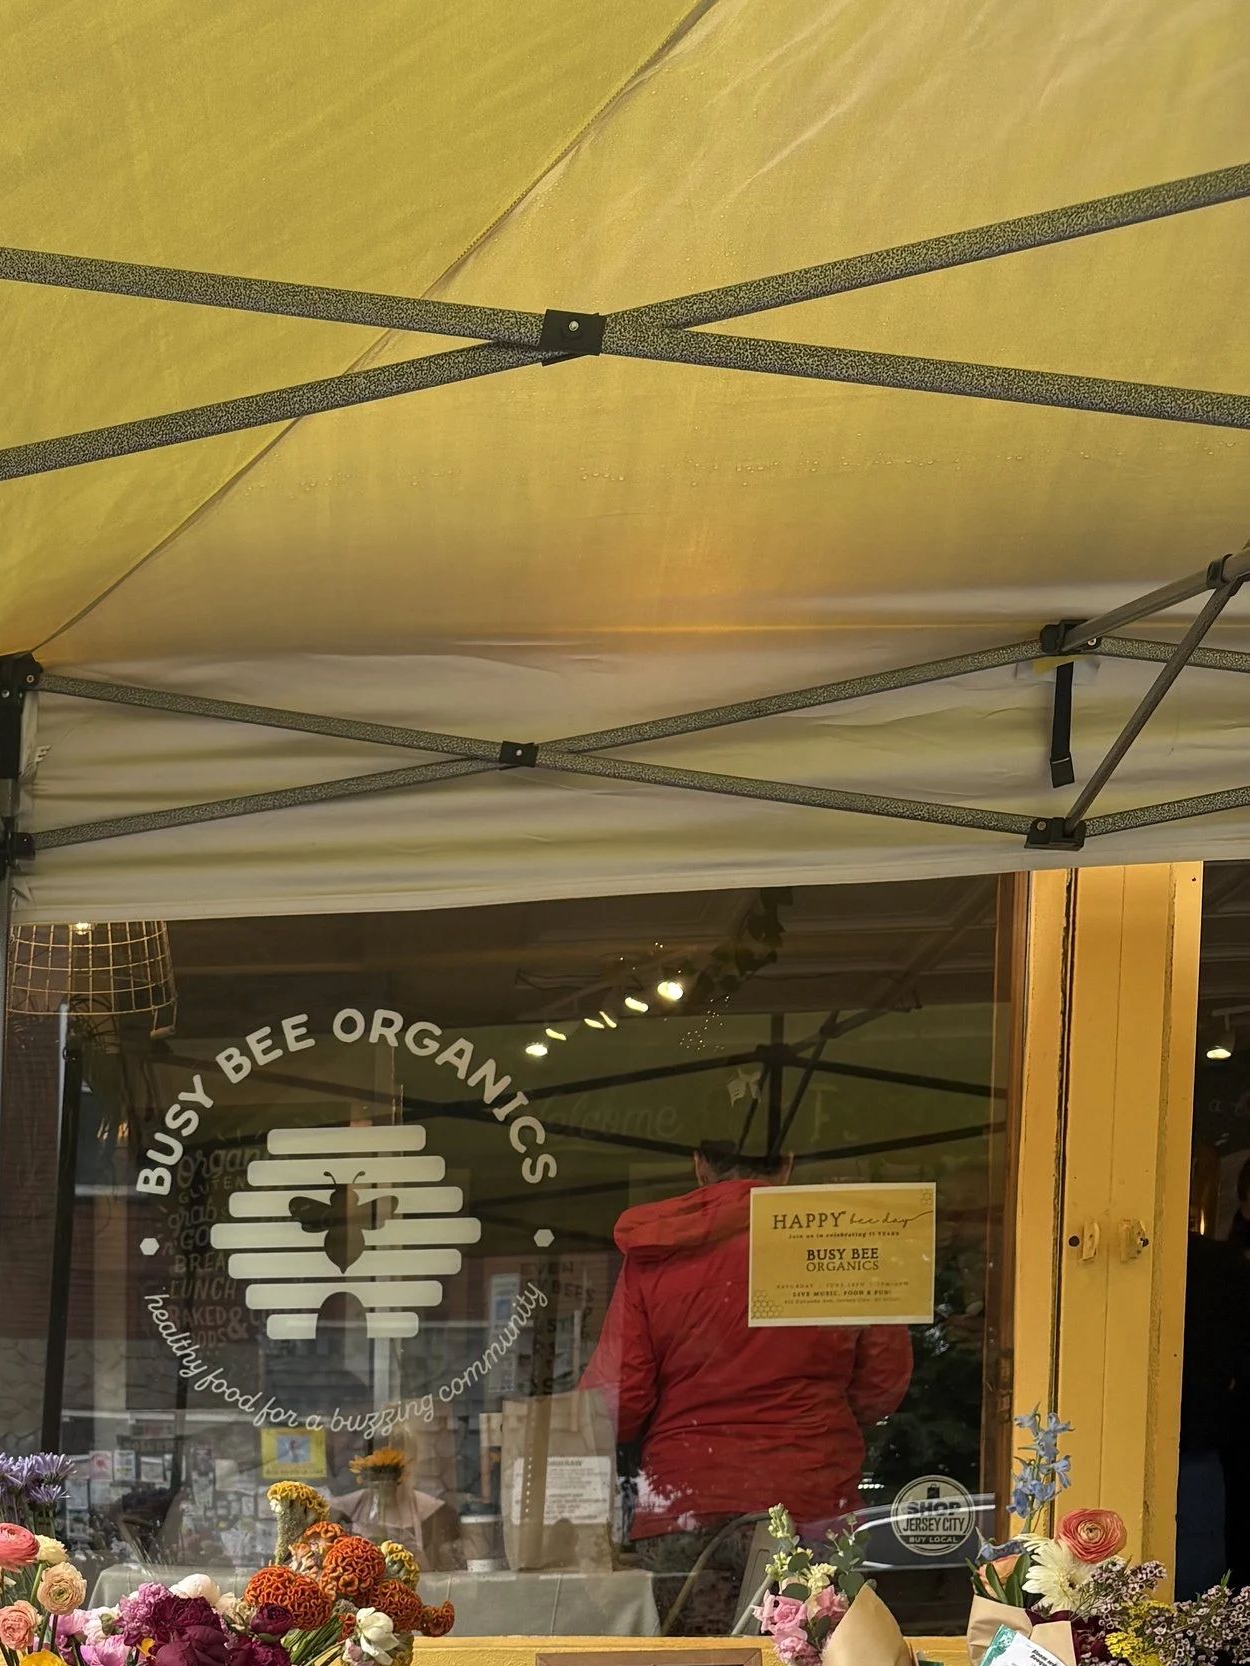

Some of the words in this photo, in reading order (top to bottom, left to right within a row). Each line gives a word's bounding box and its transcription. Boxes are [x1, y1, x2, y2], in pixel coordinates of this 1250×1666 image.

[136, 1074, 214, 1196] BUSY
[215, 1013, 316, 1084] BEE
[332, 1008, 558, 1185] ORGANICS
[773, 1211, 846, 1230] HAPPY
[882, 1210, 934, 1228] day
[806, 1249, 847, 1262] BUSY
[851, 1248, 879, 1260] BEE
[806, 1260, 880, 1273] ORGANICS
[144, 1293, 210, 1377] healthy
[194, 1367, 259, 1412] food
[254, 1399, 299, 1428] for
[305, 1413, 325, 1432] a
[330, 1392, 436, 1441] buzzing
[438, 1281, 550, 1403] community
[906, 1501, 962, 1516] SHOP
[902, 1517, 943, 1532] JERSEY
[942, 1517, 966, 1532] CITY
